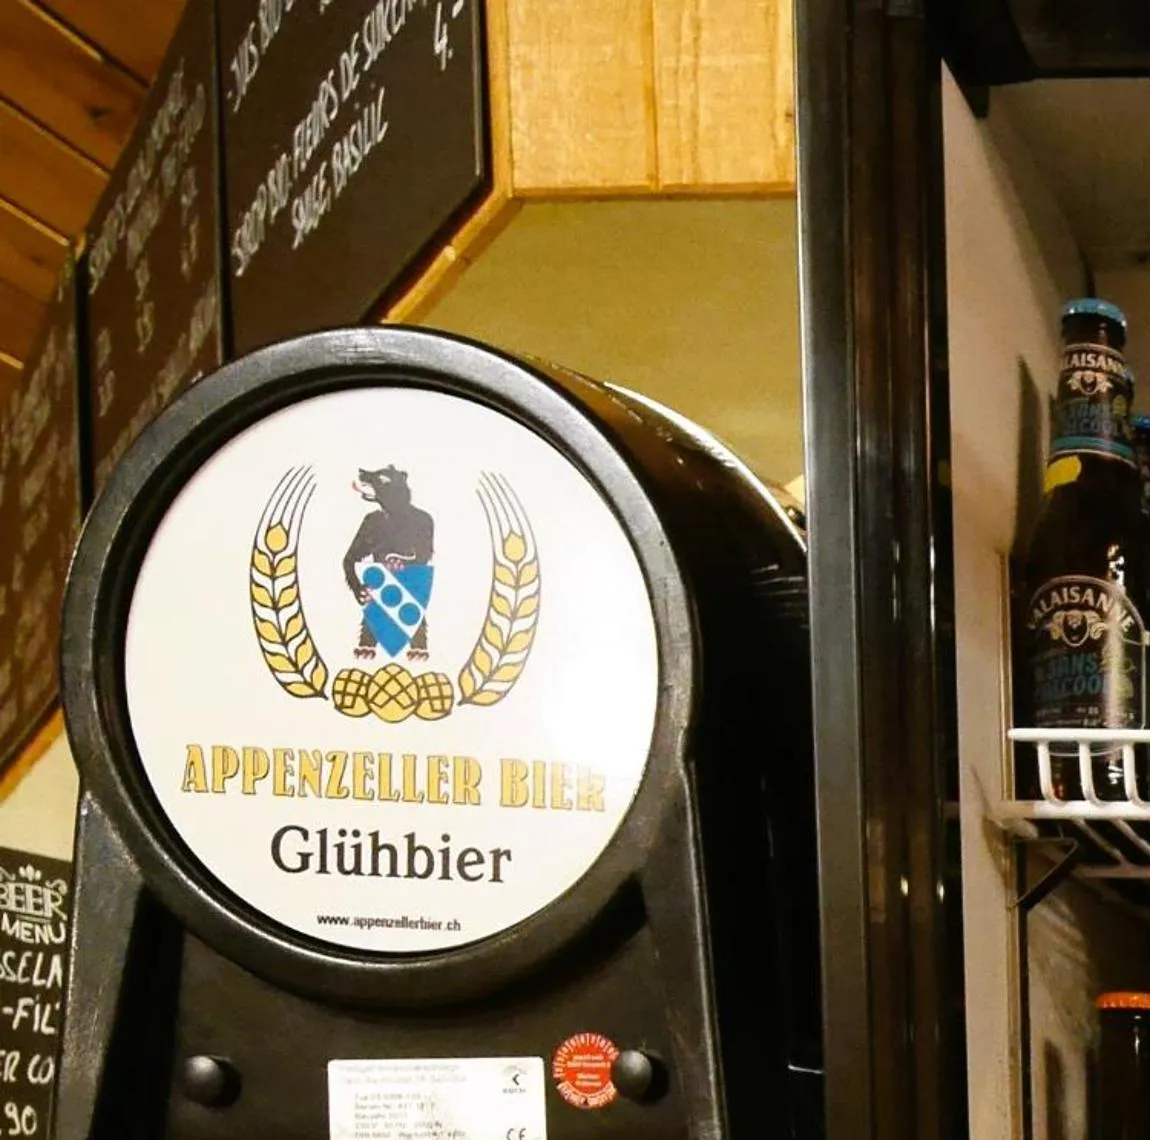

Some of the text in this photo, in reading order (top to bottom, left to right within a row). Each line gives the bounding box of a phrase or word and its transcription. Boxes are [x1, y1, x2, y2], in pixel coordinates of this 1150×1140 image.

[181, 744, 606, 812] APPENZELLER BIER
[270, 824, 512, 883] Glühbier
[1, 912, 66, 945] MENU
